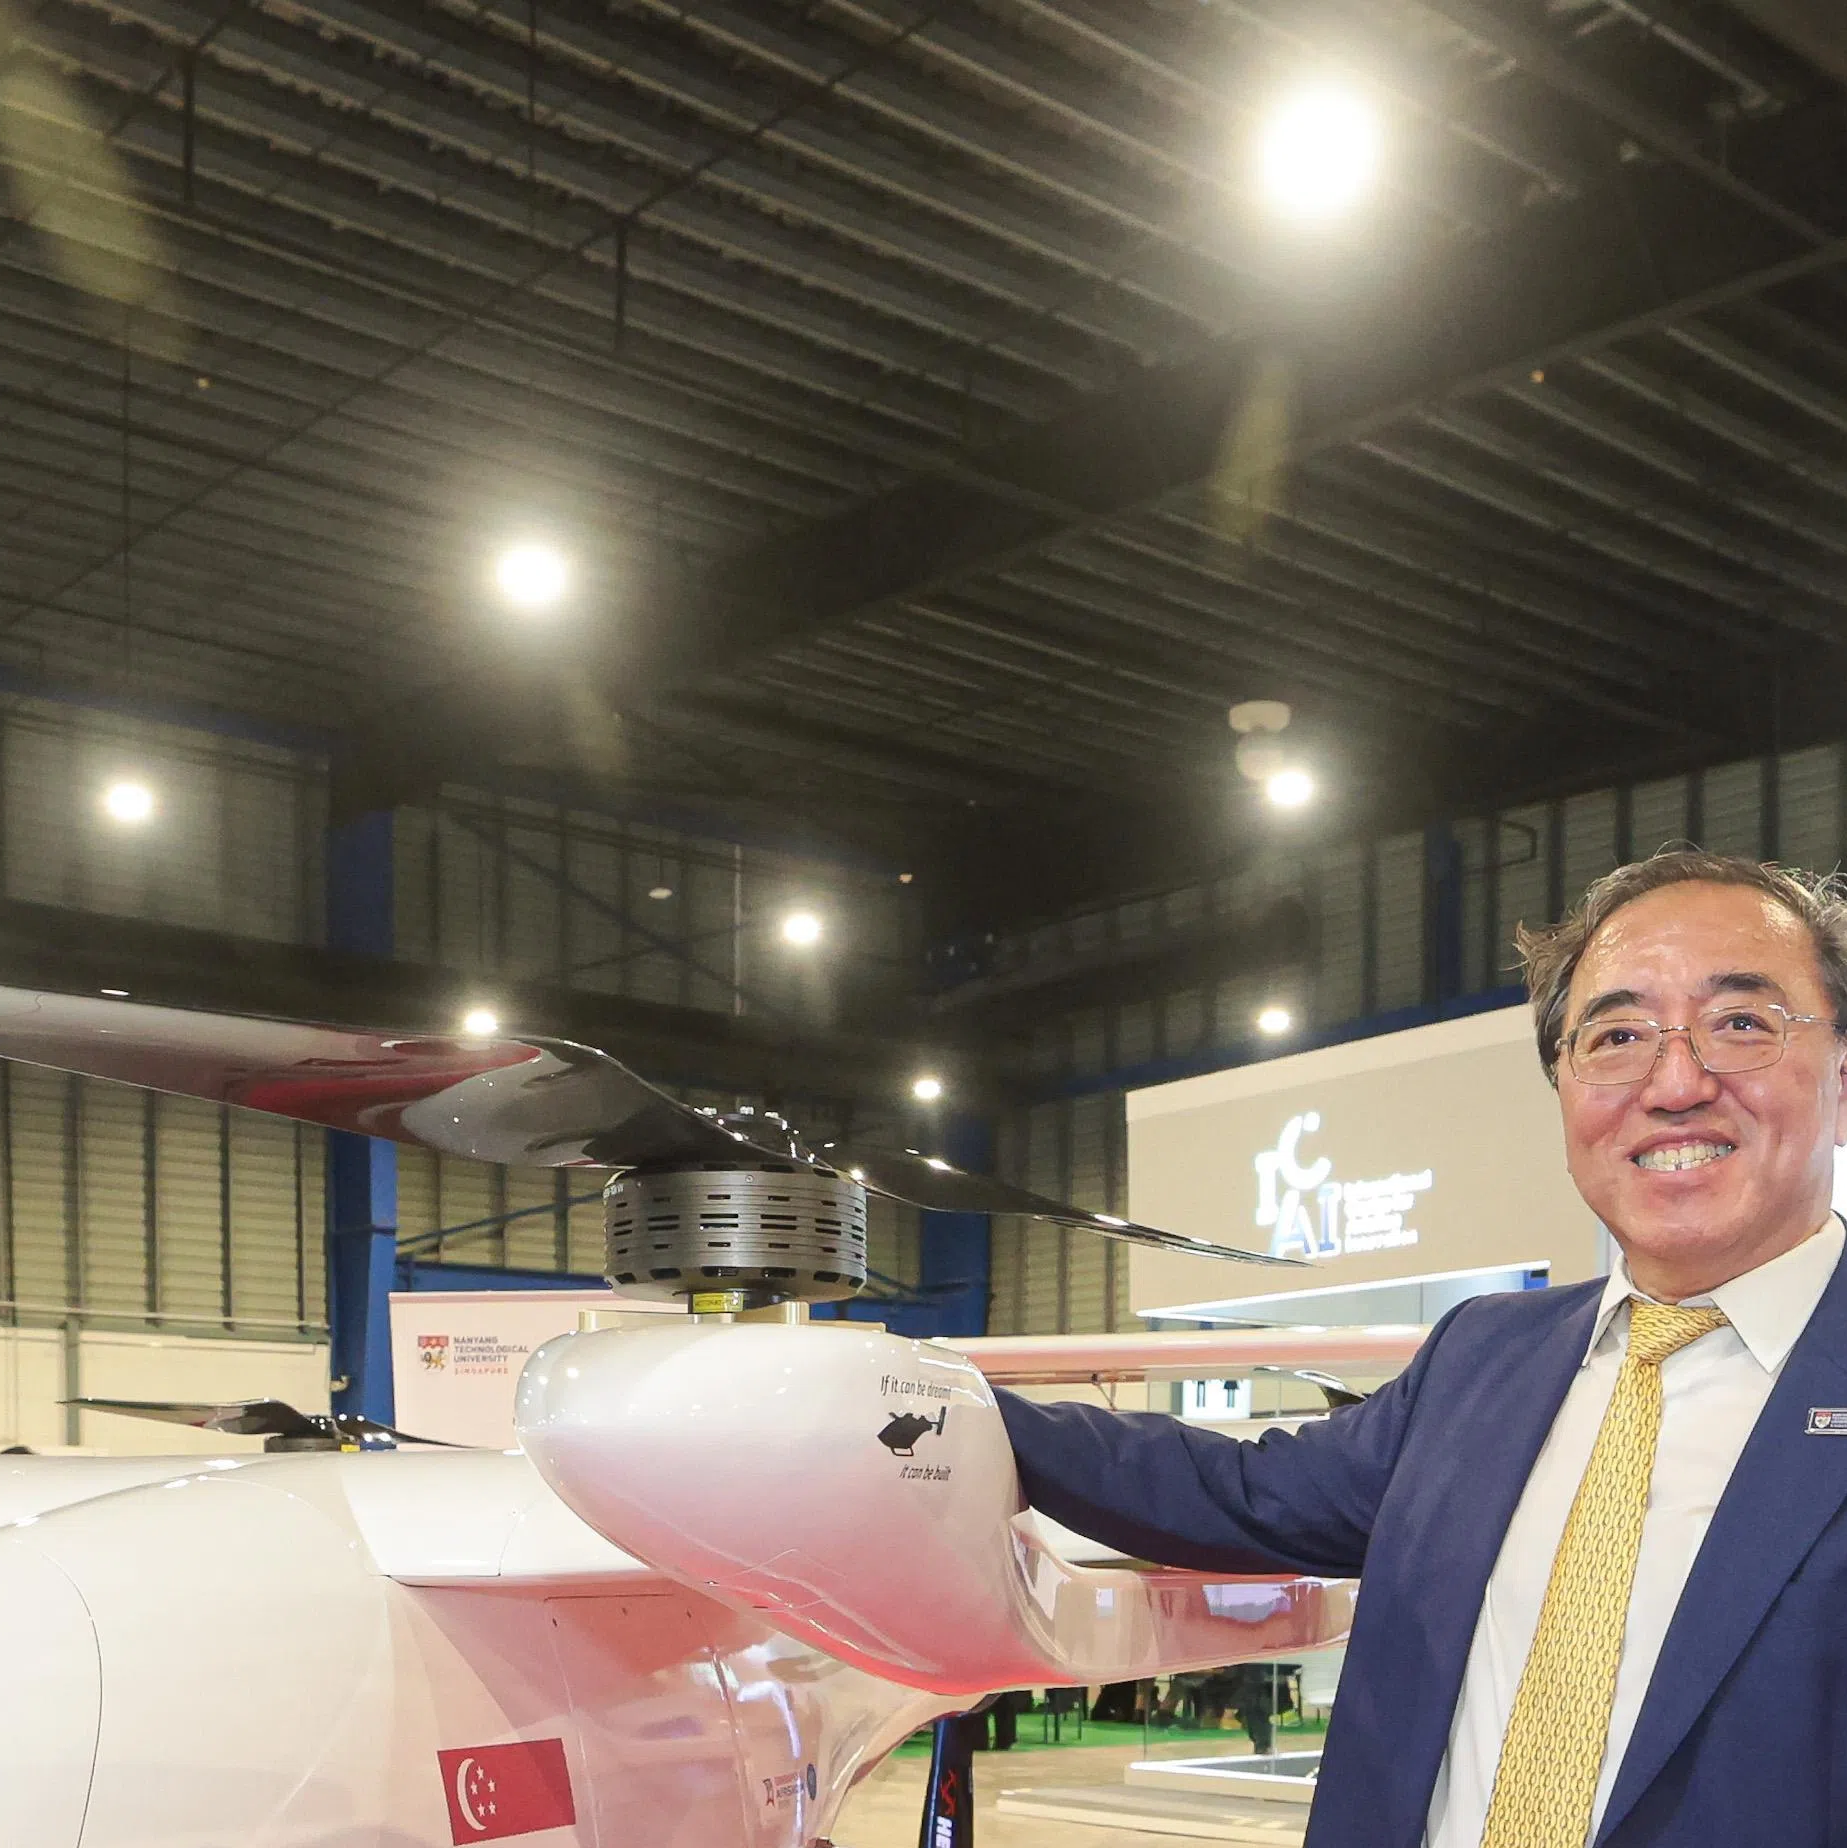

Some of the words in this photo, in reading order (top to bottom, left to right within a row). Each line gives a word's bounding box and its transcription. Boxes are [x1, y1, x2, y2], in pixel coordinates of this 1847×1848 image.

[453, 1336, 499, 1344] NANYANG
[454, 1345, 529, 1353] TECHNOLOGICAL
[453, 1355, 508, 1363] UNIVERSITY
[880, 1374, 890, 1396] If
[891, 1376, 898, 1393] it
[900, 1380, 916, 1395] can
[916, 1379, 927, 1396] be
